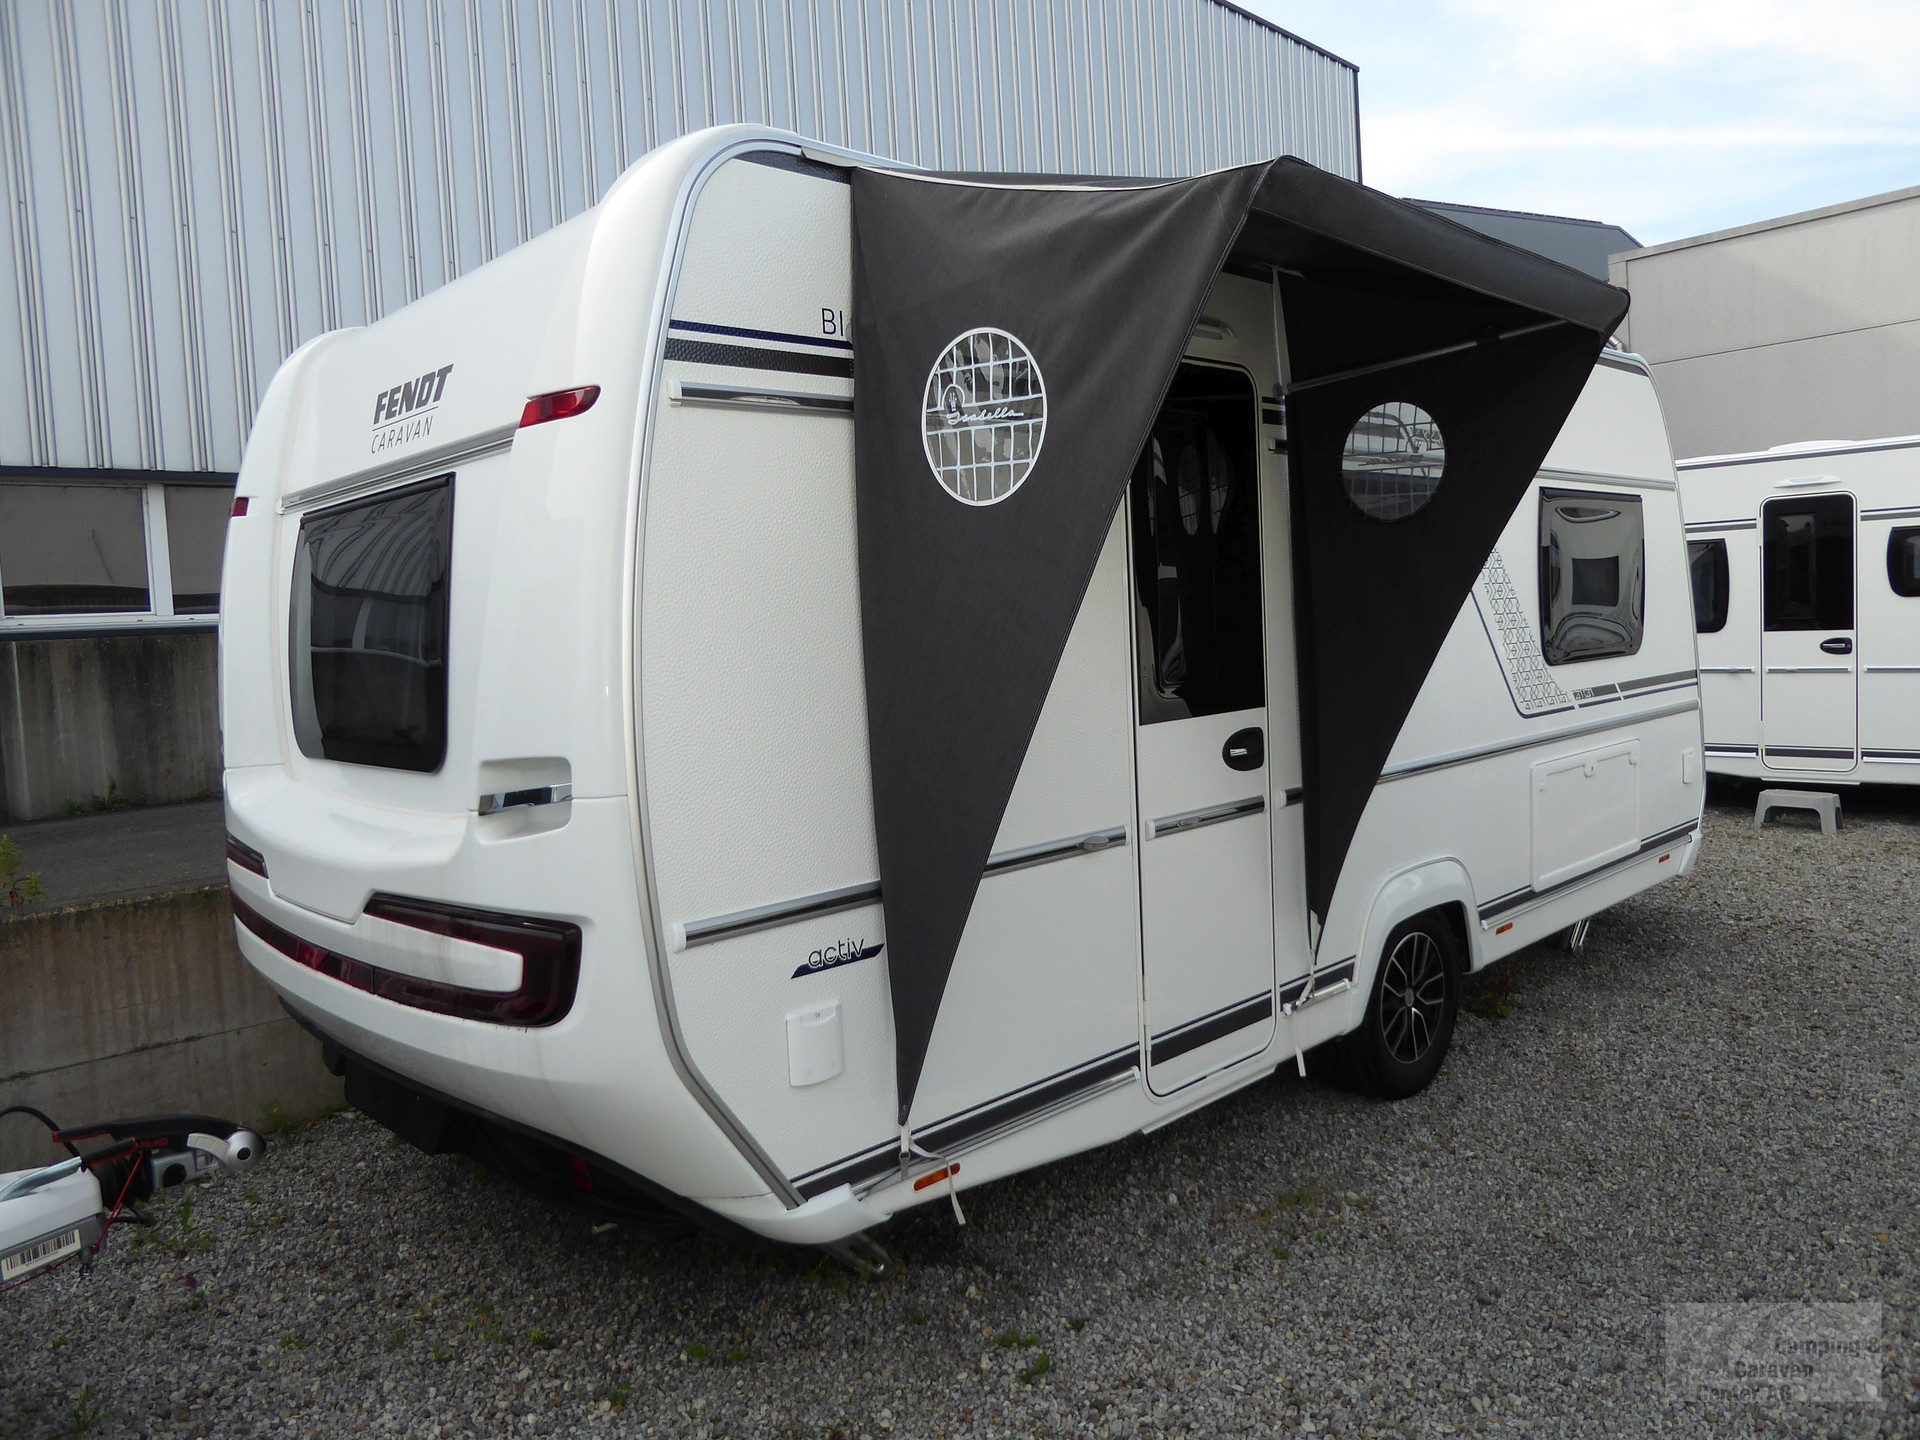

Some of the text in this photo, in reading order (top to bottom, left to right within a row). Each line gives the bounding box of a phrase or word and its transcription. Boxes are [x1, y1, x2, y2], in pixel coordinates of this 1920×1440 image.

[373, 363, 455, 425] FENDT
[371, 415, 434, 455] CARAVAN
[808, 937, 865, 968] activ
